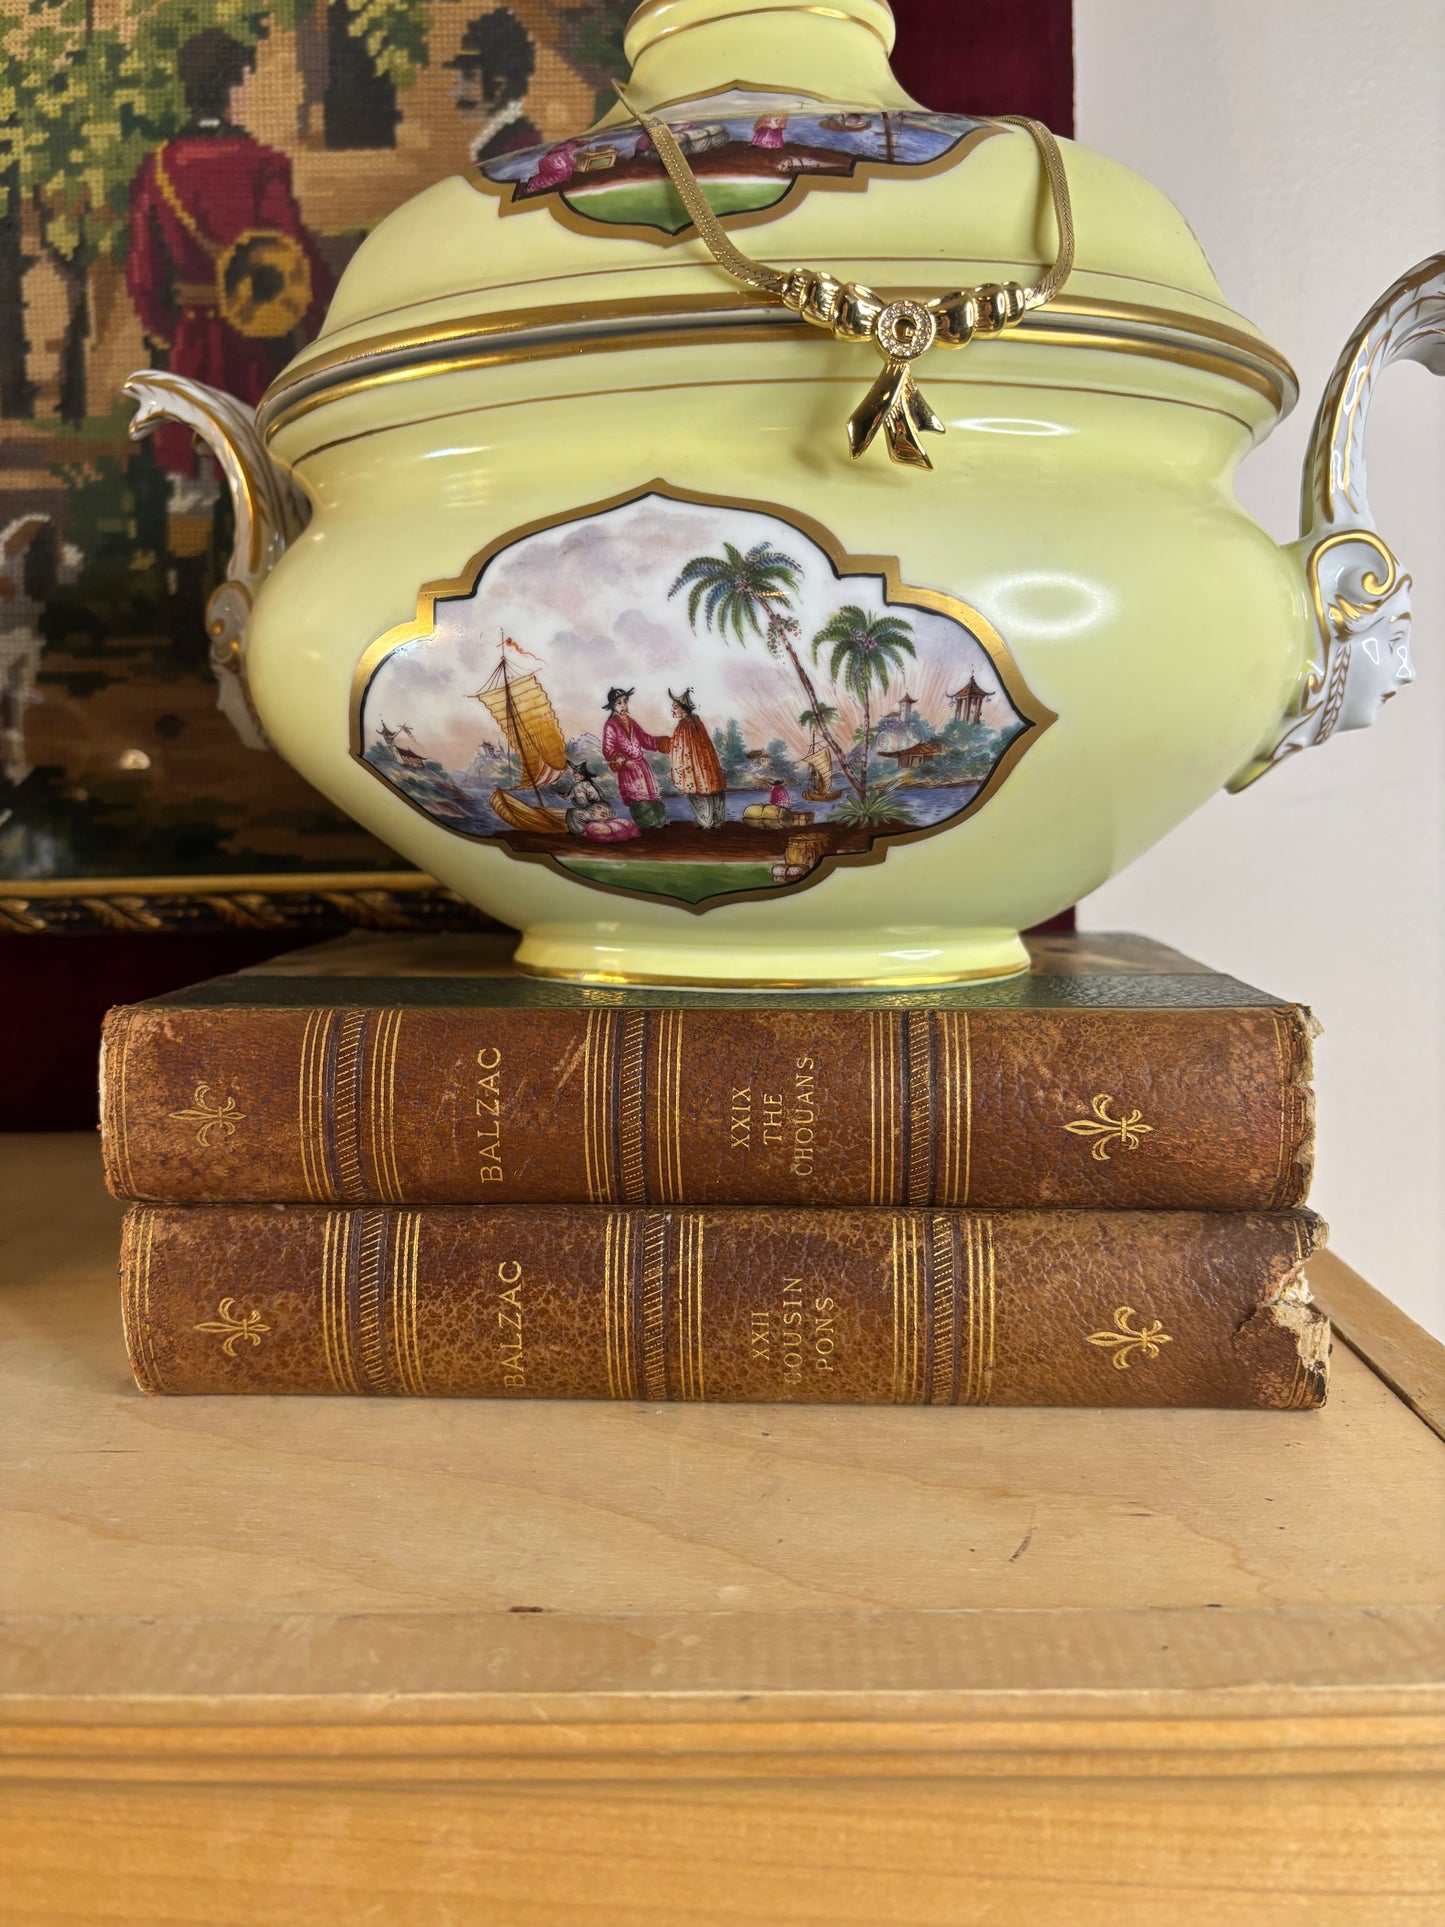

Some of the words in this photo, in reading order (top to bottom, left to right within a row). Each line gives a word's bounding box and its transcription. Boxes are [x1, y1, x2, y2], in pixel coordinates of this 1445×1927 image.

[477, 1047, 504, 1184] BALZAC
[731, 1086, 751, 1151] XXIX
[763, 1093, 783, 1145] THE
[793, 1056, 815, 1177] CHOUANS
[498, 1260, 525, 1388] BALZAC
[751, 1309, 770, 1361] XXII
[783, 1277, 803, 1384] COUSIN
[815, 1297, 834, 1372] PONS
